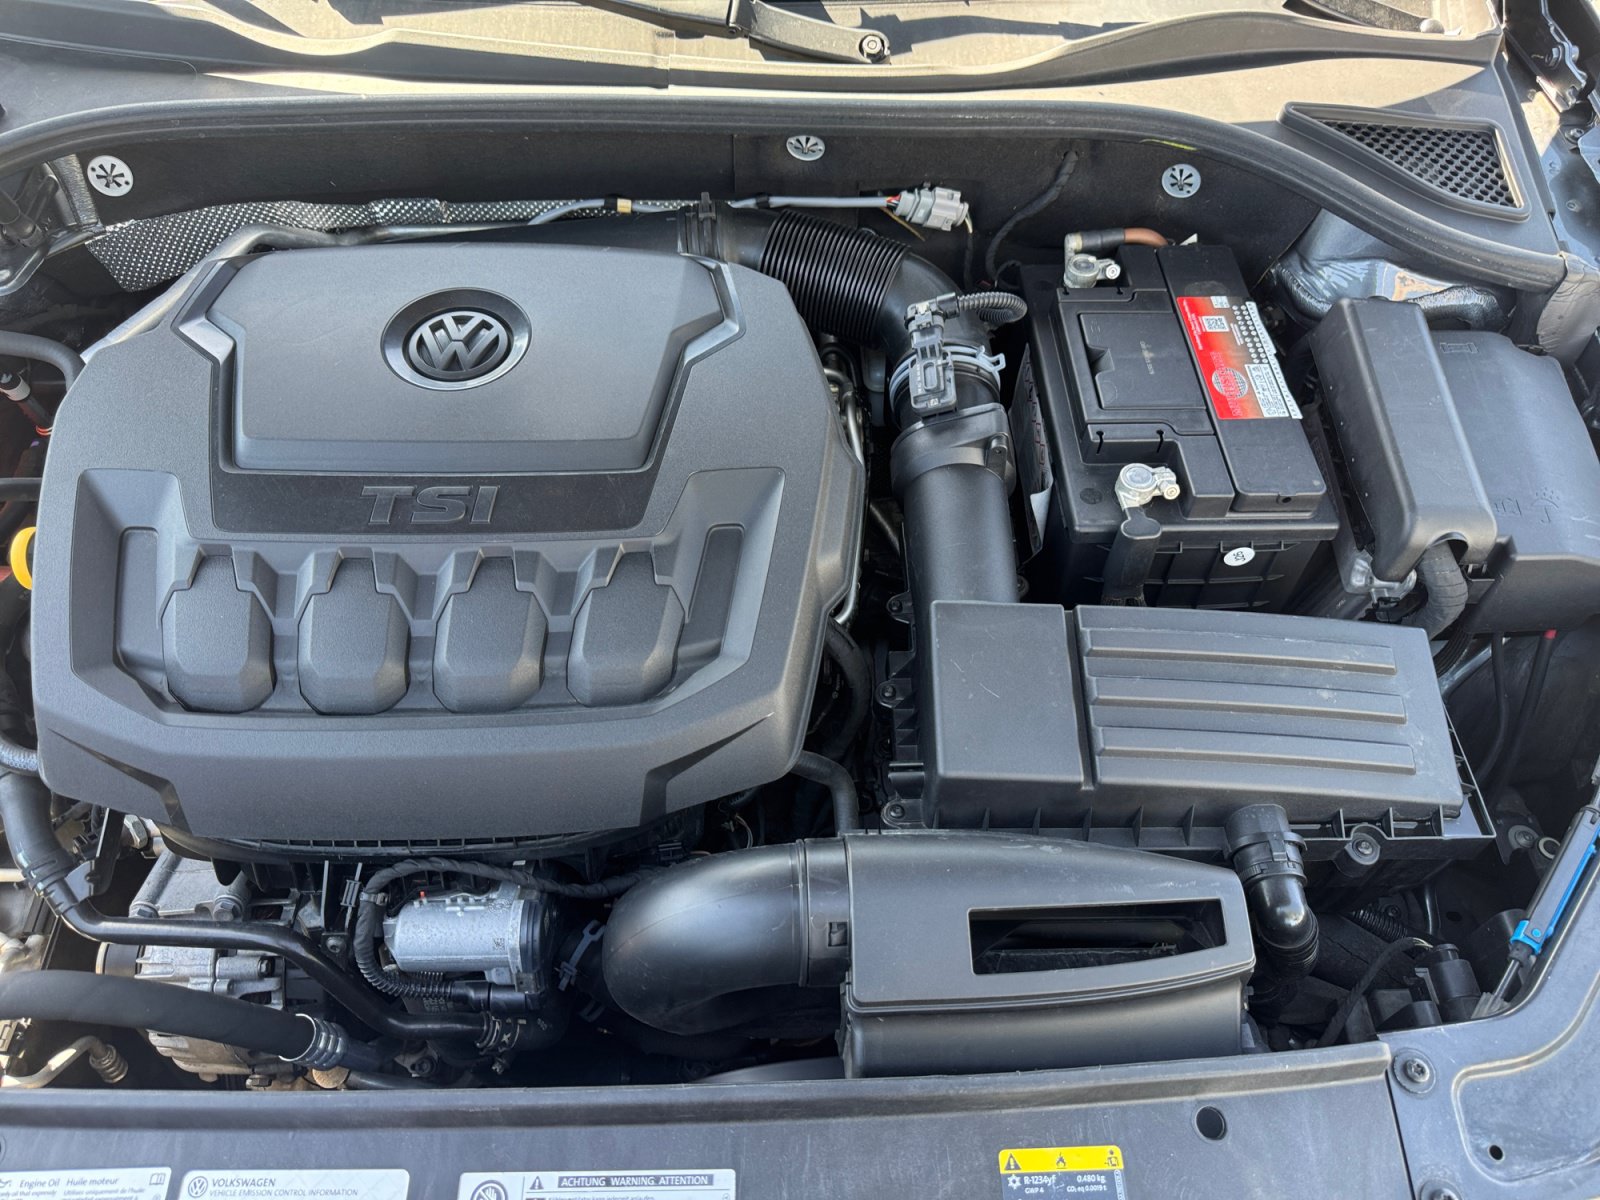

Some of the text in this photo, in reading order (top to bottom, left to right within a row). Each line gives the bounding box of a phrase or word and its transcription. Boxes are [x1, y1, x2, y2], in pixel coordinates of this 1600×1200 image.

[410, 311, 507, 377] VW
[361, 485, 498, 523] TSI
[20, 1178, 60, 1189] Engine Oil
[66, 1177, 119, 1186] Huile moteur
[212, 1178, 275, 1187] VOLKSWAGEN
[561, 1175, 708, 1187] ACHTUNG WARNING ATTENTION
[1023, 1175, 1056, 1186] R-1234yf
[209, 1188, 358, 1197] VEHICLE EMISSION CONTROL INFORMATION
